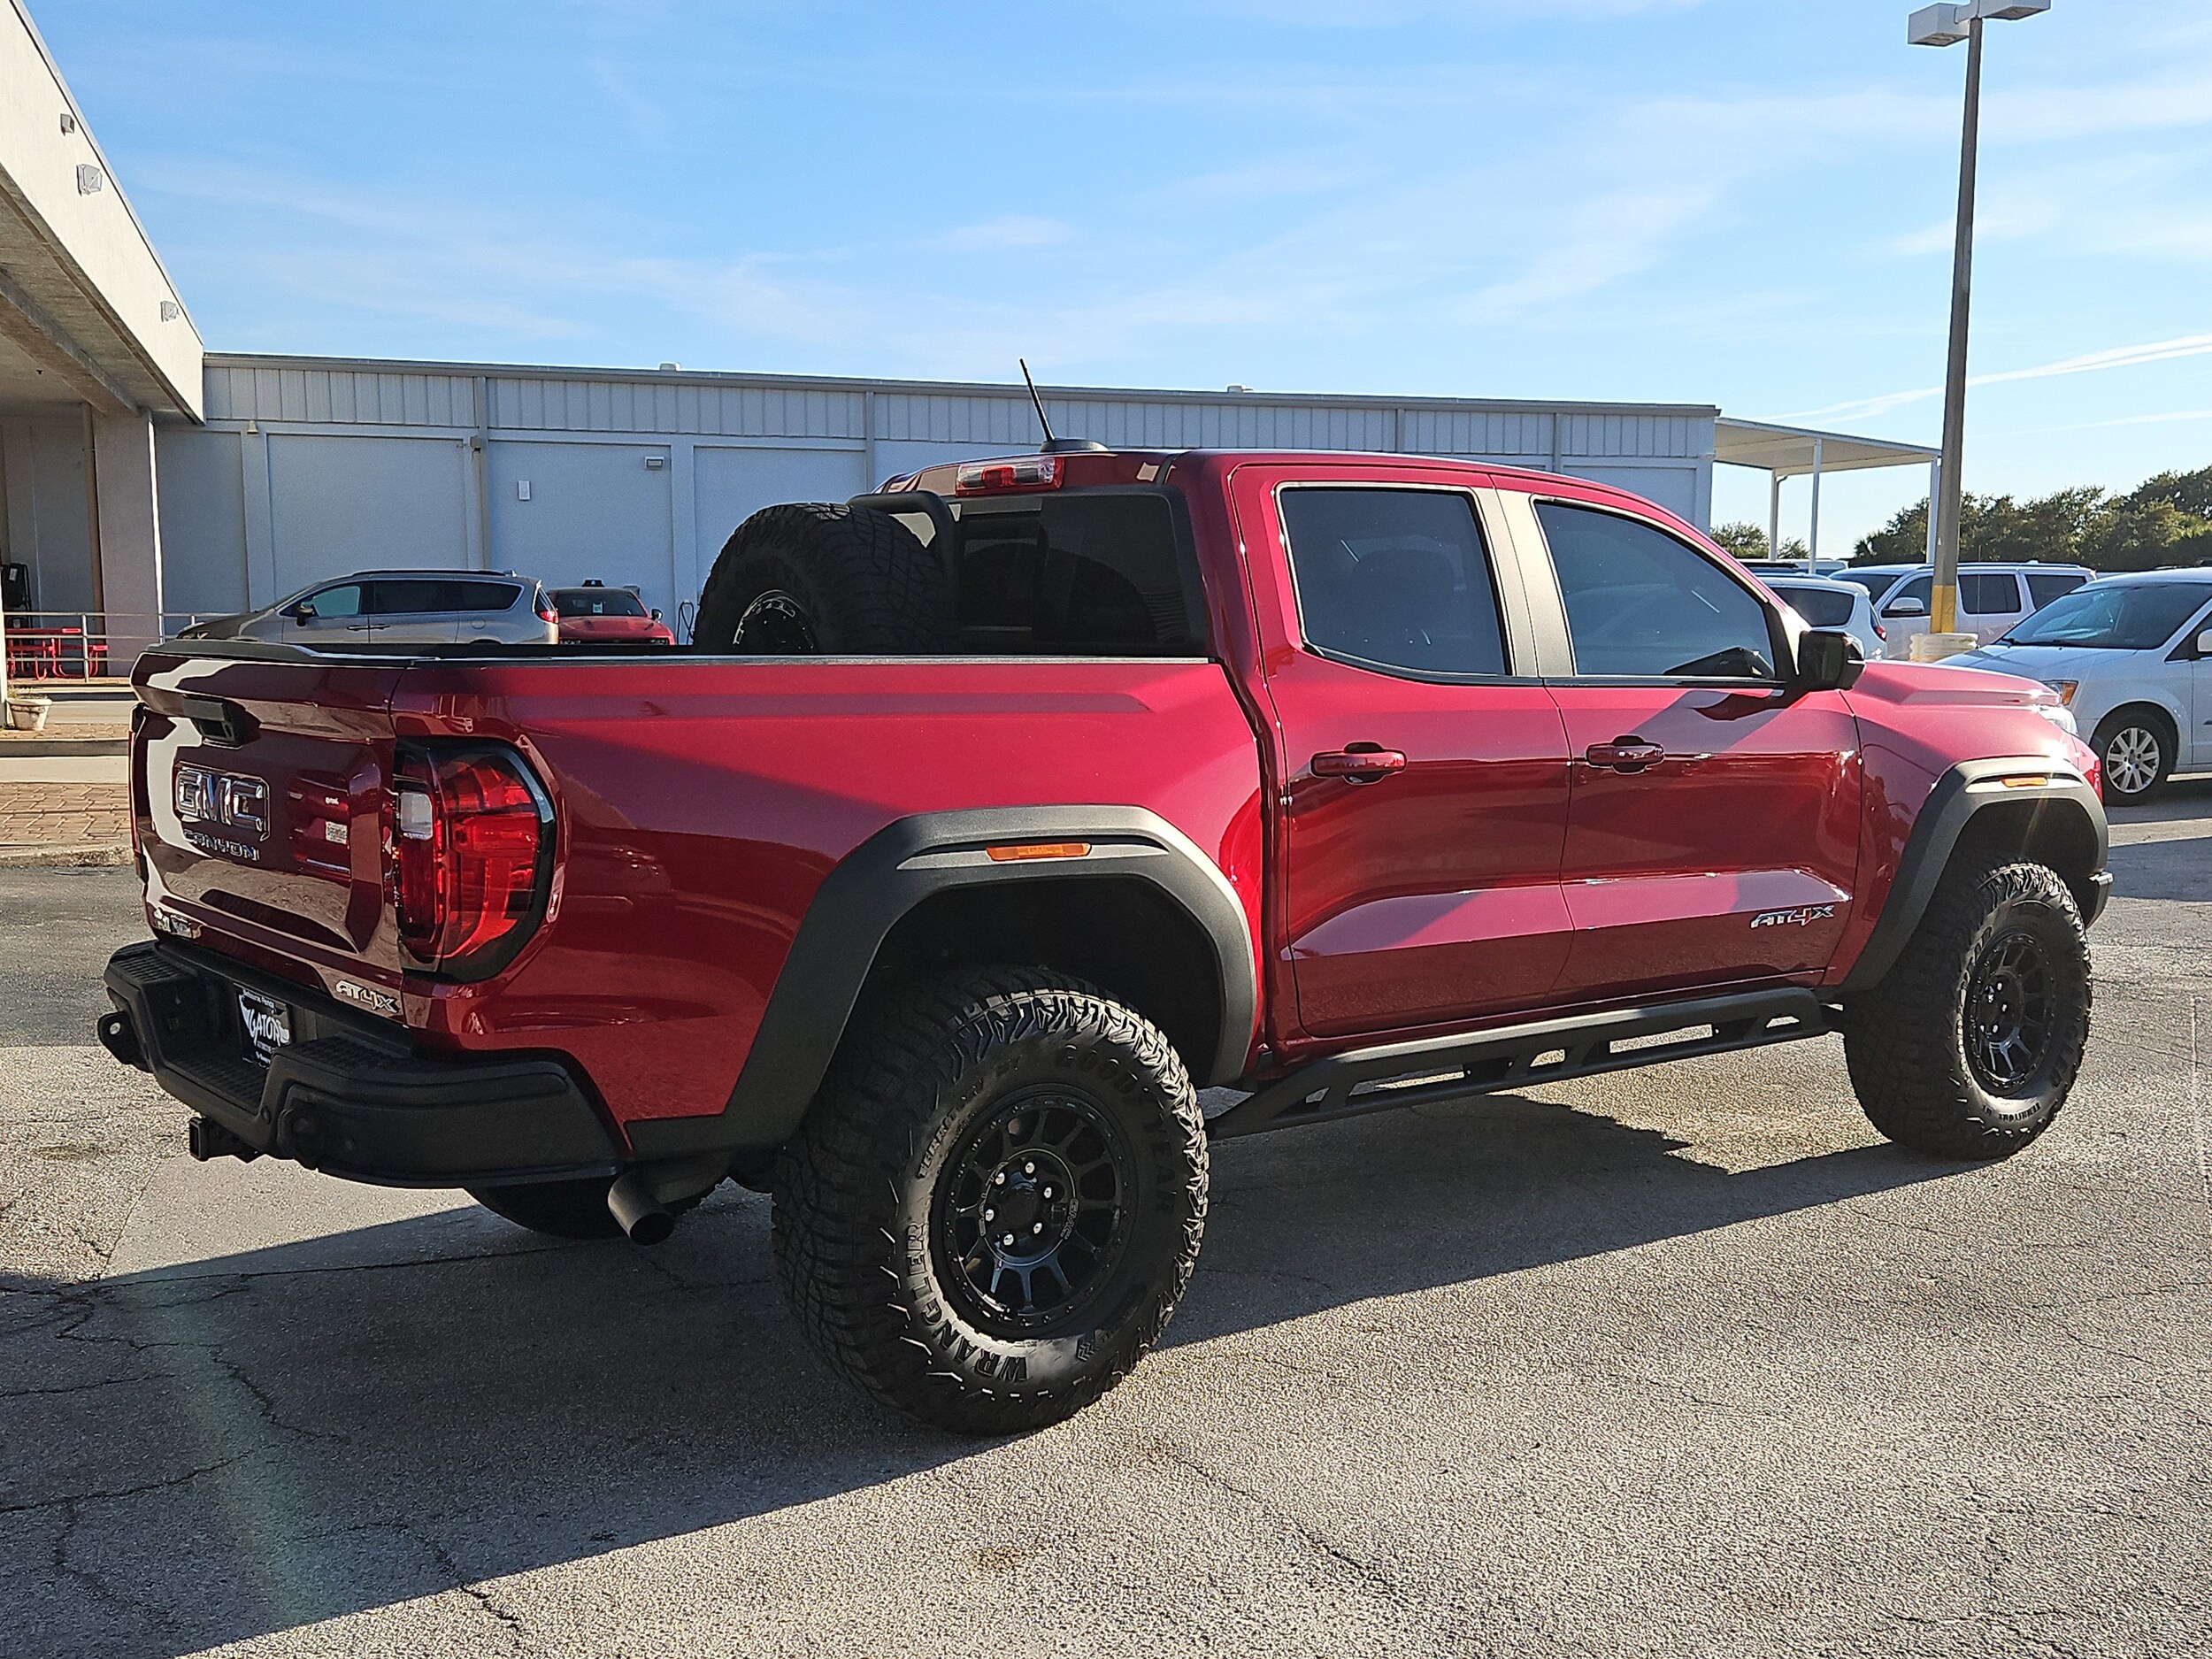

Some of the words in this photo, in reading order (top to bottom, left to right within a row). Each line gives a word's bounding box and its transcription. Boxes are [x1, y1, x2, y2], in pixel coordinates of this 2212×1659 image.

[177, 766, 264, 832] GMC
[182, 828, 260, 861] CANYON
[1750, 904, 1835, 929] AT4X
[335, 979, 398, 1014] AT4X
[248, 1008, 282, 1048] GATOR
[1059, 1197, 1079, 1240] GMC
[905, 1222, 1030, 1383] WRANGLER
